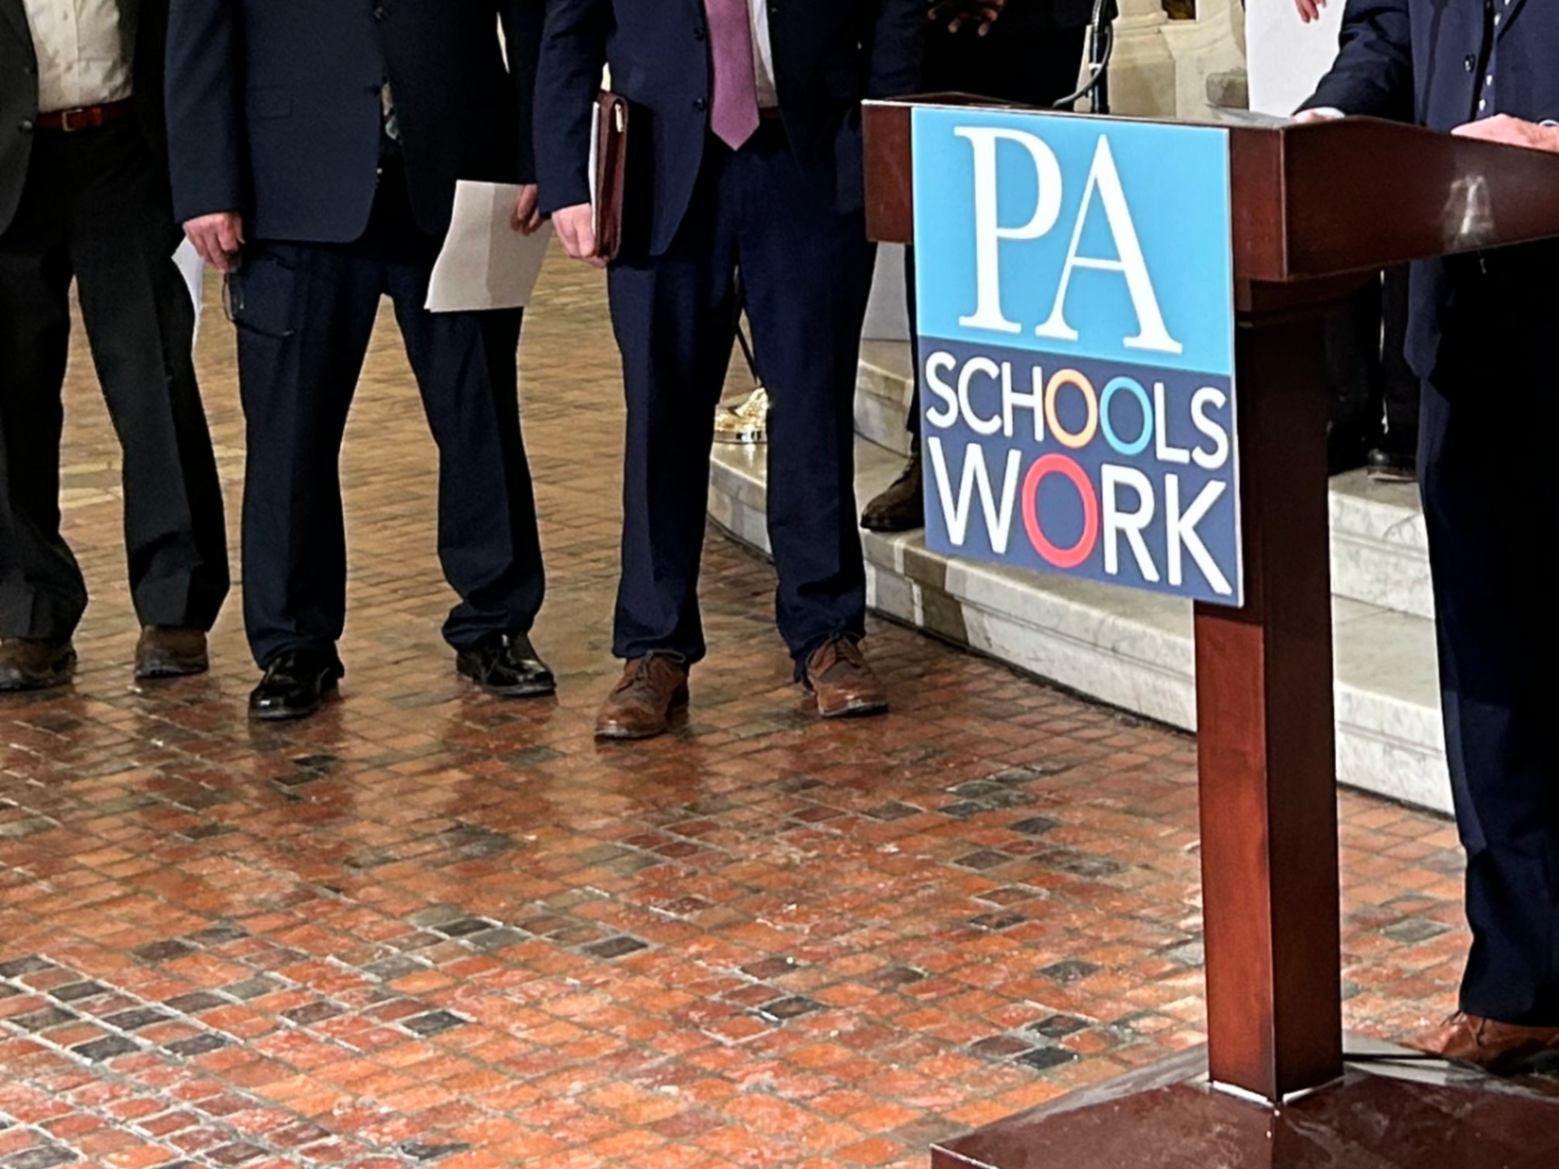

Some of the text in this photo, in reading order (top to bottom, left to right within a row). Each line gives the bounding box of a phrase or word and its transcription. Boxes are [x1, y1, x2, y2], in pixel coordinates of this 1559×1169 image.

[953, 125, 1183, 355] PA
[924, 350, 1230, 470] SCHOOLS
[927, 436, 1232, 596] WORK
